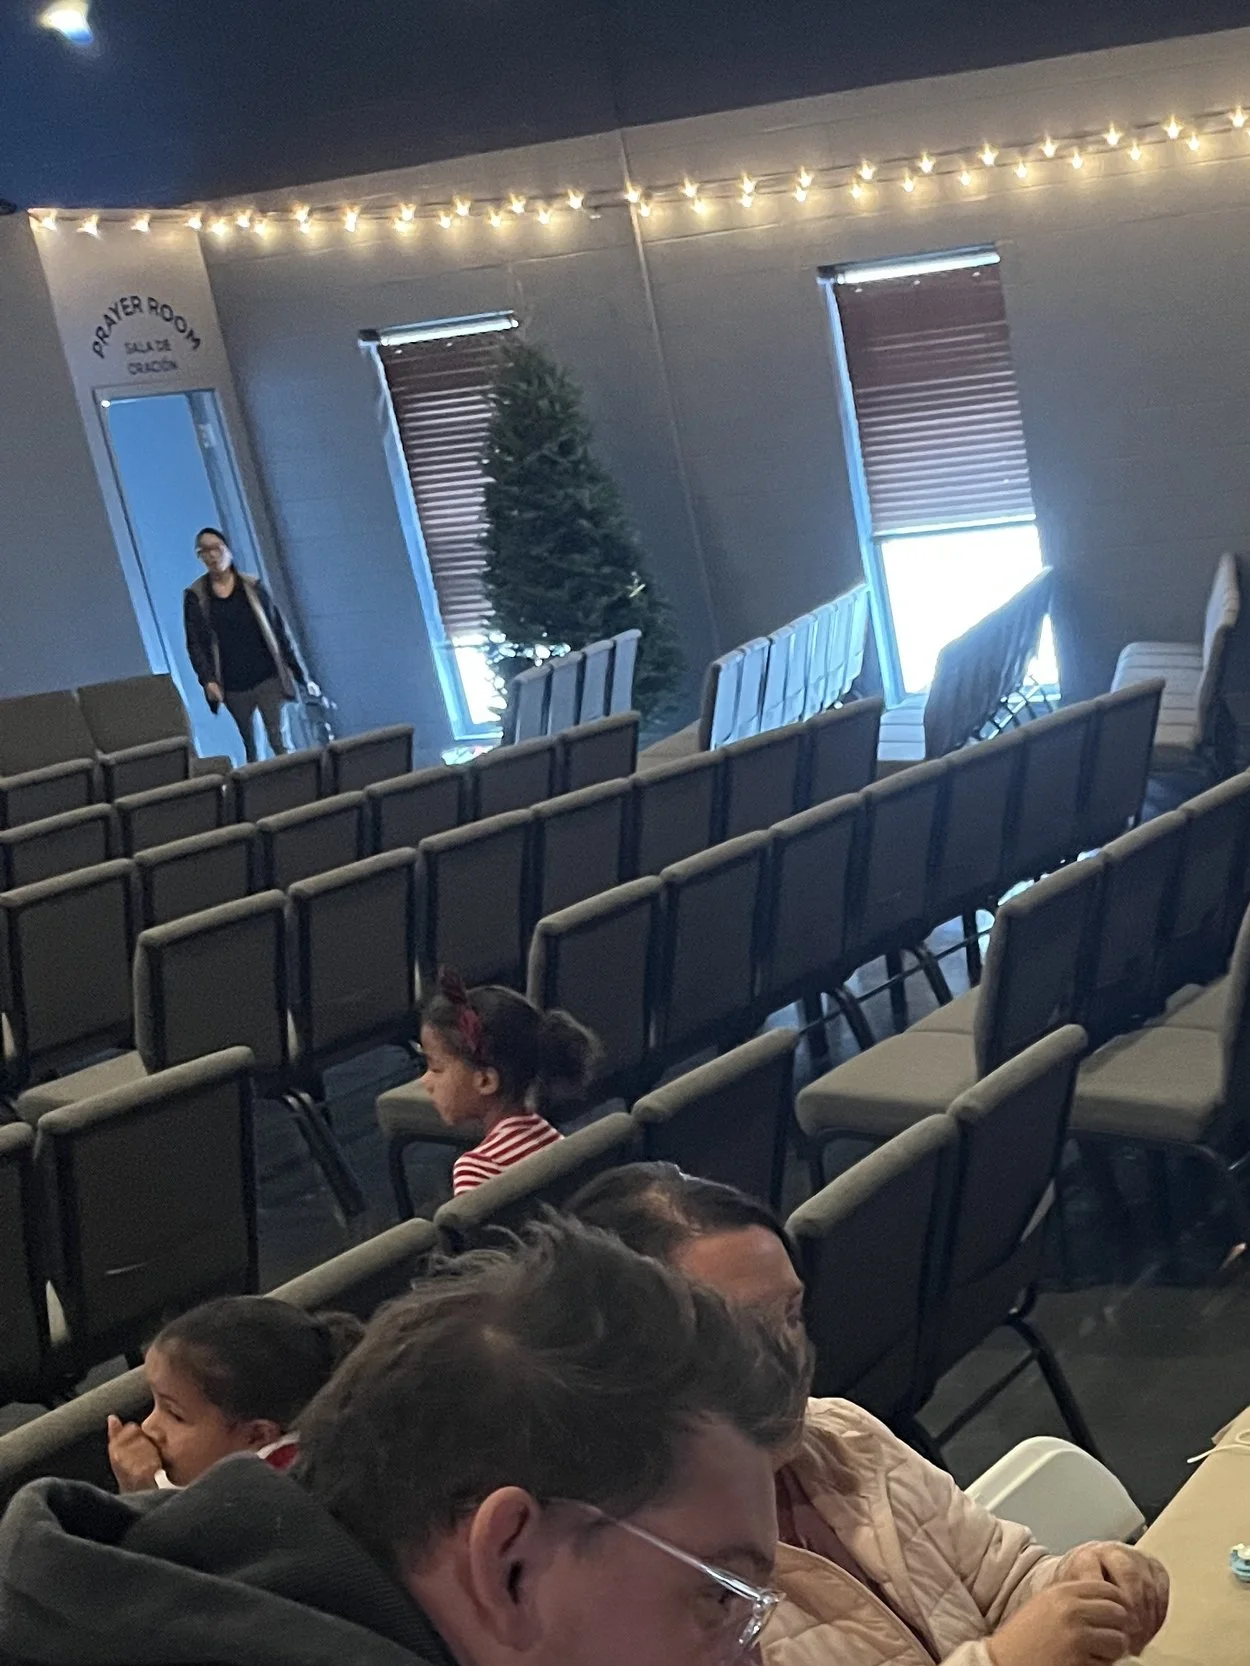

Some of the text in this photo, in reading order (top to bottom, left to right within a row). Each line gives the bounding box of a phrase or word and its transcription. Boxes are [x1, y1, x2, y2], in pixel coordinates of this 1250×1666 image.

[92, 295, 201, 359] PRAYER ROOM
[124, 339, 172, 354] SALA DE
